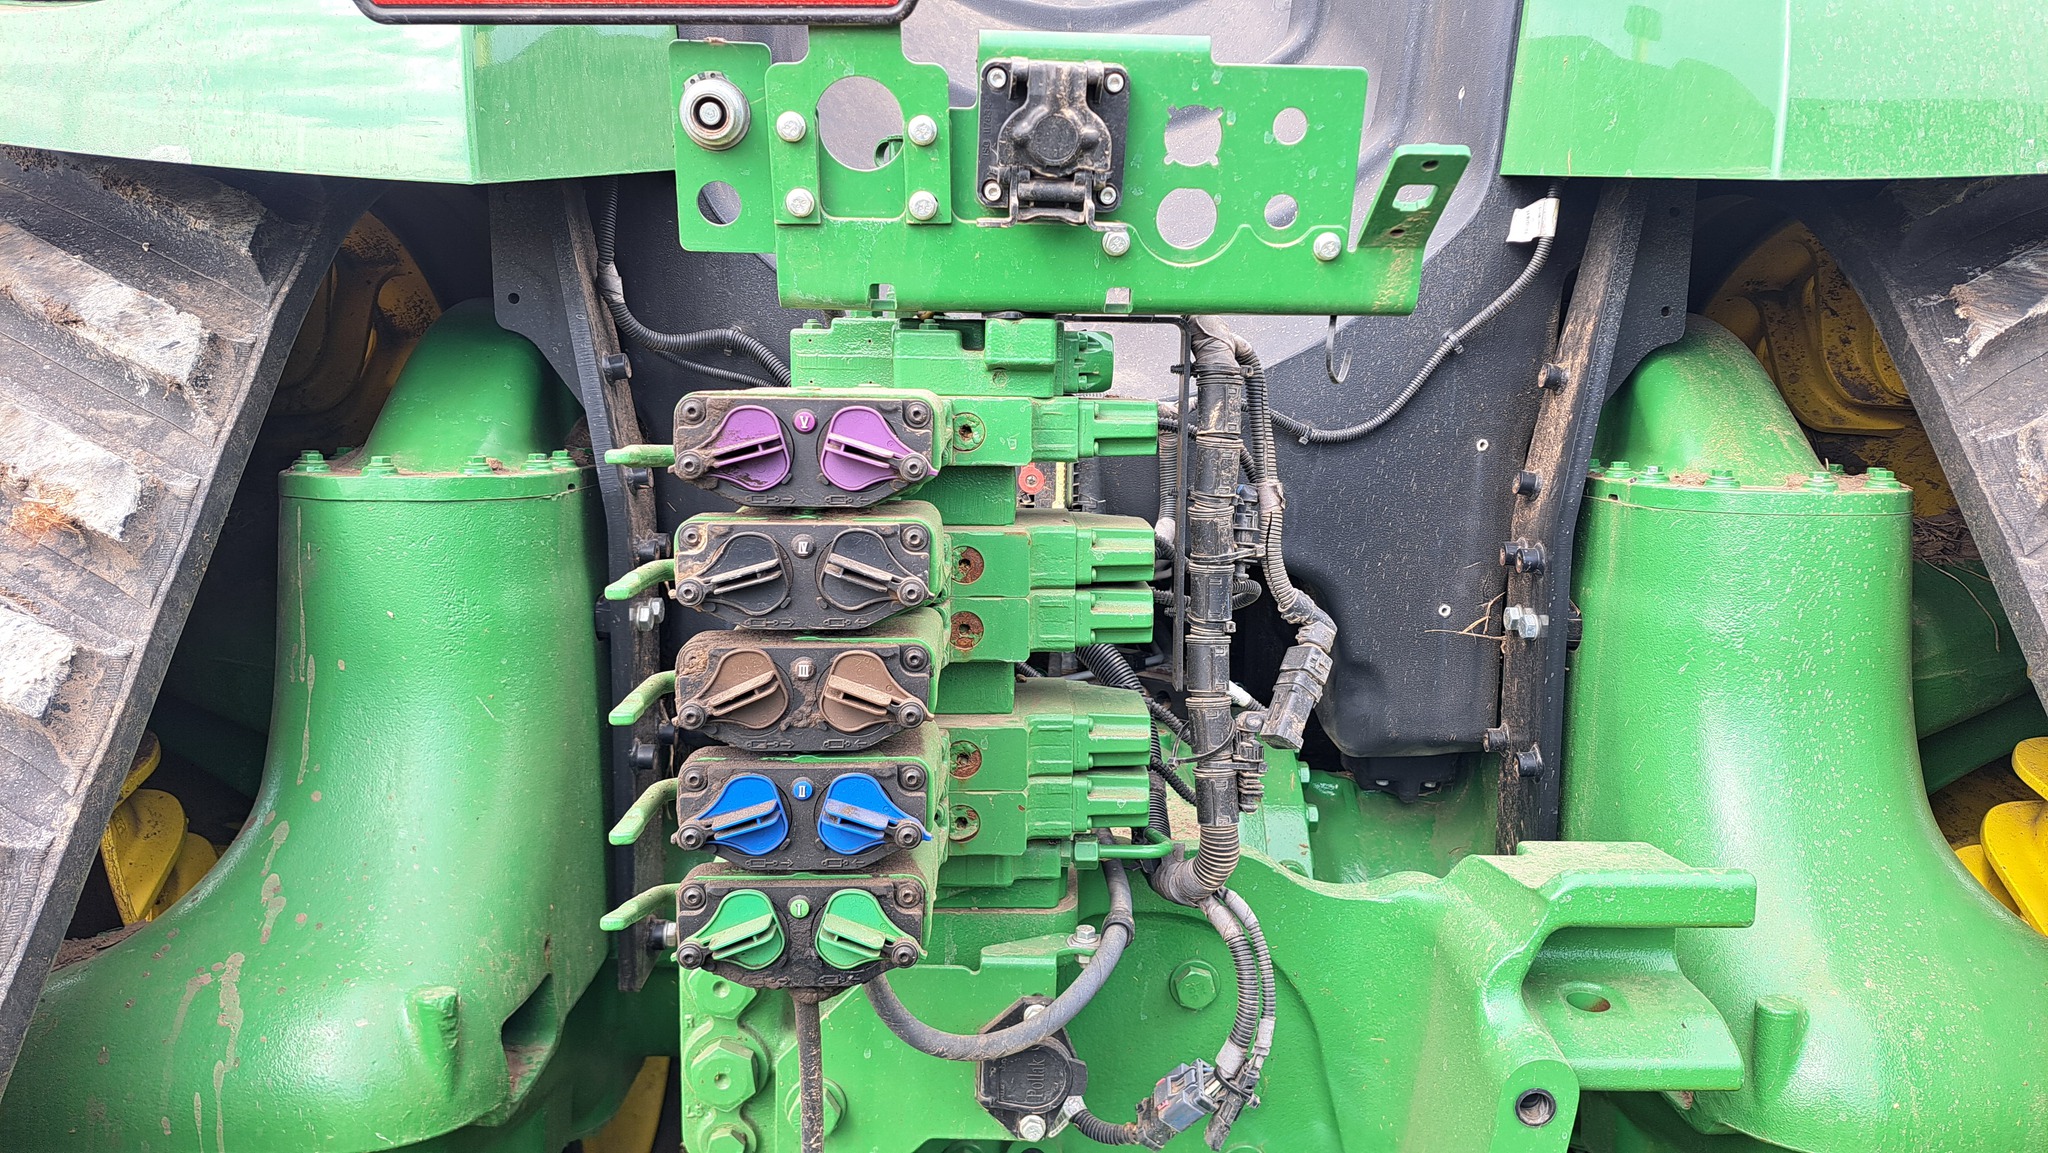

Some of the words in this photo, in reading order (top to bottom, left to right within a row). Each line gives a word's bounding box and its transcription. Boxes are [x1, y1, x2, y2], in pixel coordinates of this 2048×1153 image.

[982, 140, 991, 156] ISO
[800, 415, 810, 429] V
[798, 541, 809, 555] IV
[798, 664, 809, 678] III
[798, 785, 806, 798] II
[796, 904, 803, 916] I
[1027, 1058, 1046, 1101] Pollak
